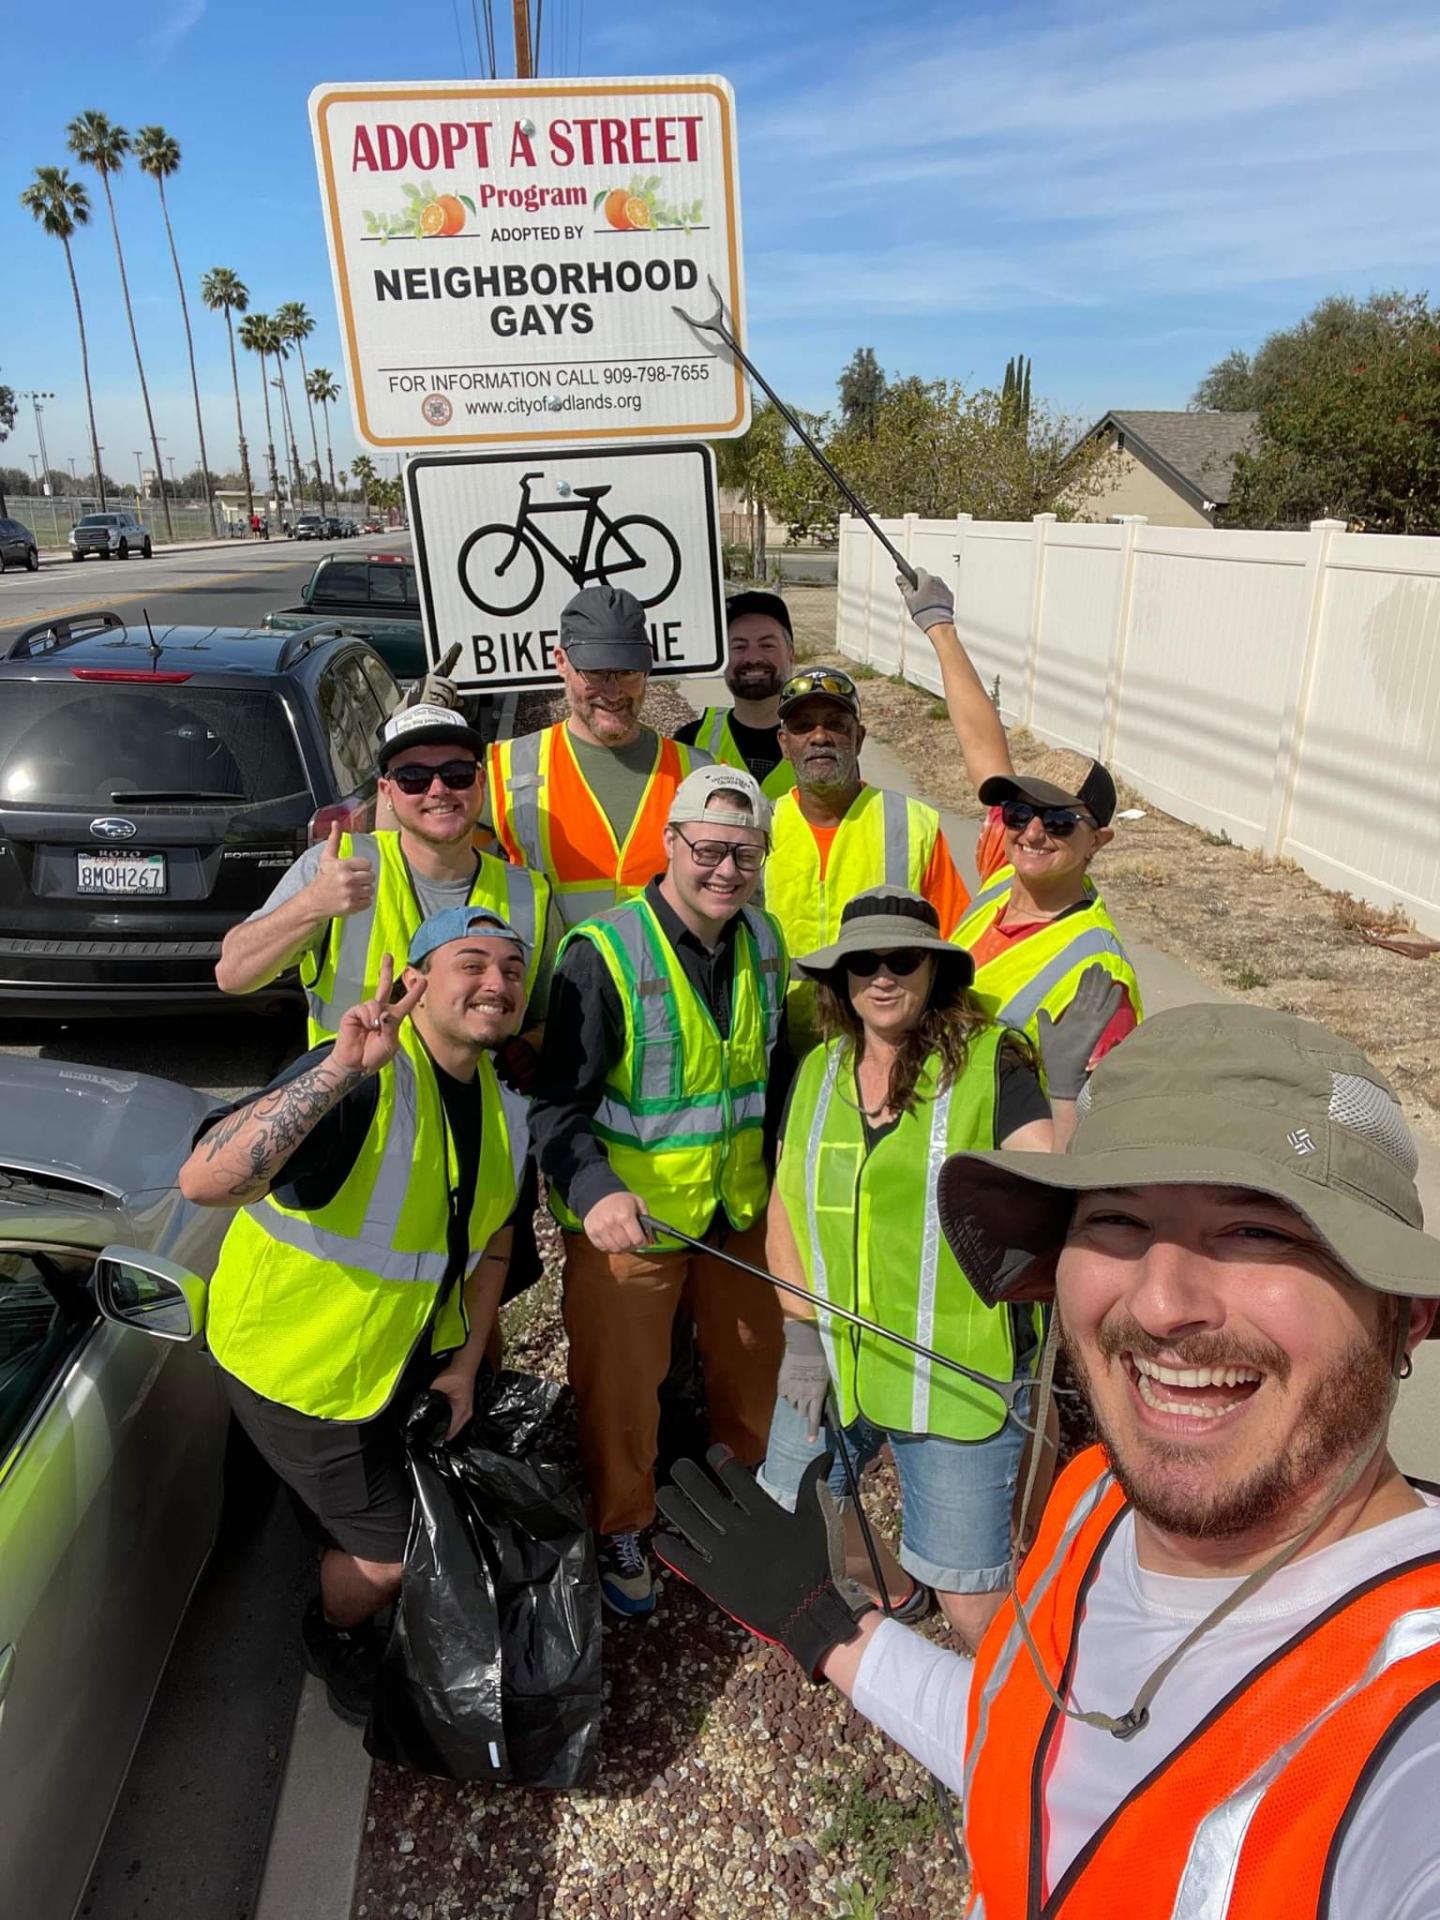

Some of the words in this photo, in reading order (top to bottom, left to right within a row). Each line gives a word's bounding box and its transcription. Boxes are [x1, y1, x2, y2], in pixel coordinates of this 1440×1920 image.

[352, 121, 493, 172] ADOPT
[509, 120, 537, 168] A
[548, 115, 704, 167] STREET
[479, 183, 588, 212] Program
[490, 226, 561, 243] ADOPTED
[564, 225, 584, 240] BY
[373, 258, 698, 302] NEIGHBORHOOD
[490, 302, 594, 338] GAYS
[389, 373, 427, 394] FOR
[431, 368, 552, 391] INFORMATION
[556, 368, 600, 387] CALL
[603, 364, 710, 384] 909-798-7655
[465, 393, 642, 417] www.cityofdlands.org
[472, 629, 558, 675] BIKE
[81, 866, 160, 888] 8MQH267
